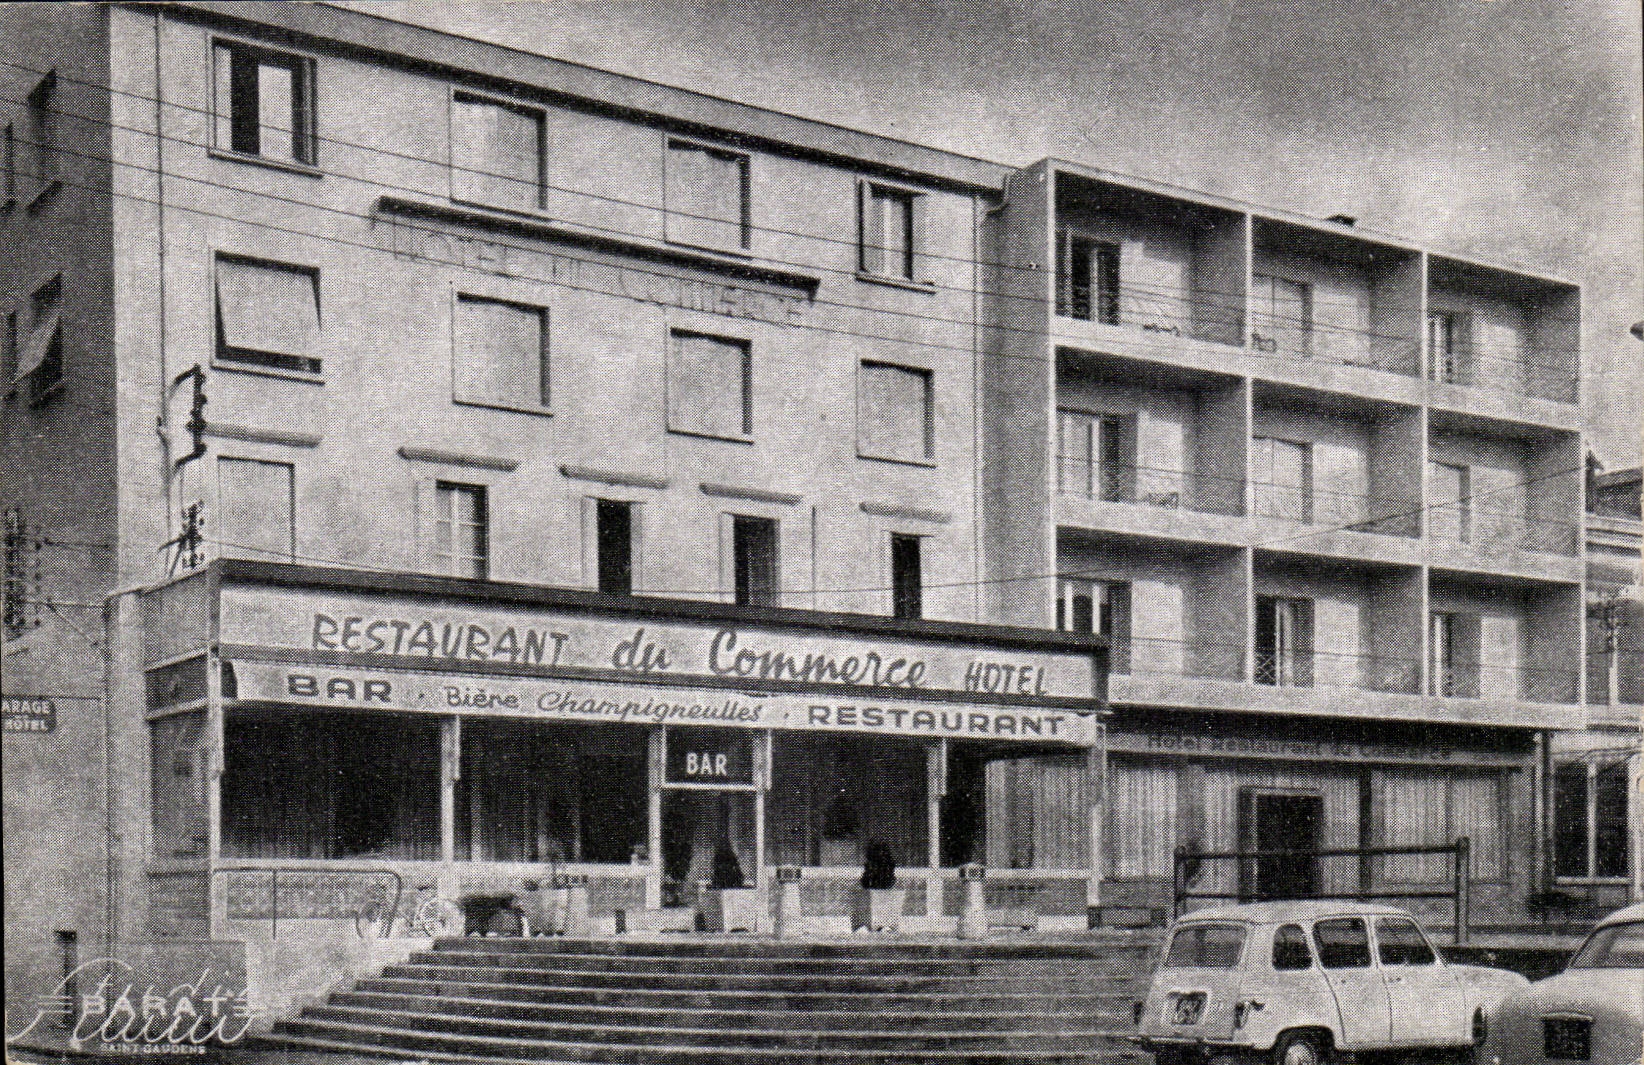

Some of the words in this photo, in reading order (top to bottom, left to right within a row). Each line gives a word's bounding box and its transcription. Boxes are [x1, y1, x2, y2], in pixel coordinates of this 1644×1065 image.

[313, 613, 570, 668] RESTAURANT
[612, 628, 672, 676] du
[708, 628, 928, 689] Commerce
[963, 659, 1050, 698] HOTEL
[287, 675, 394, 703] BAR
[446, 686, 519, 712] Bière
[536, 690, 763, 723] Champigneulles
[808, 704, 1065, 736] RESTAURANT
[685, 751, 728, 778] BAR
